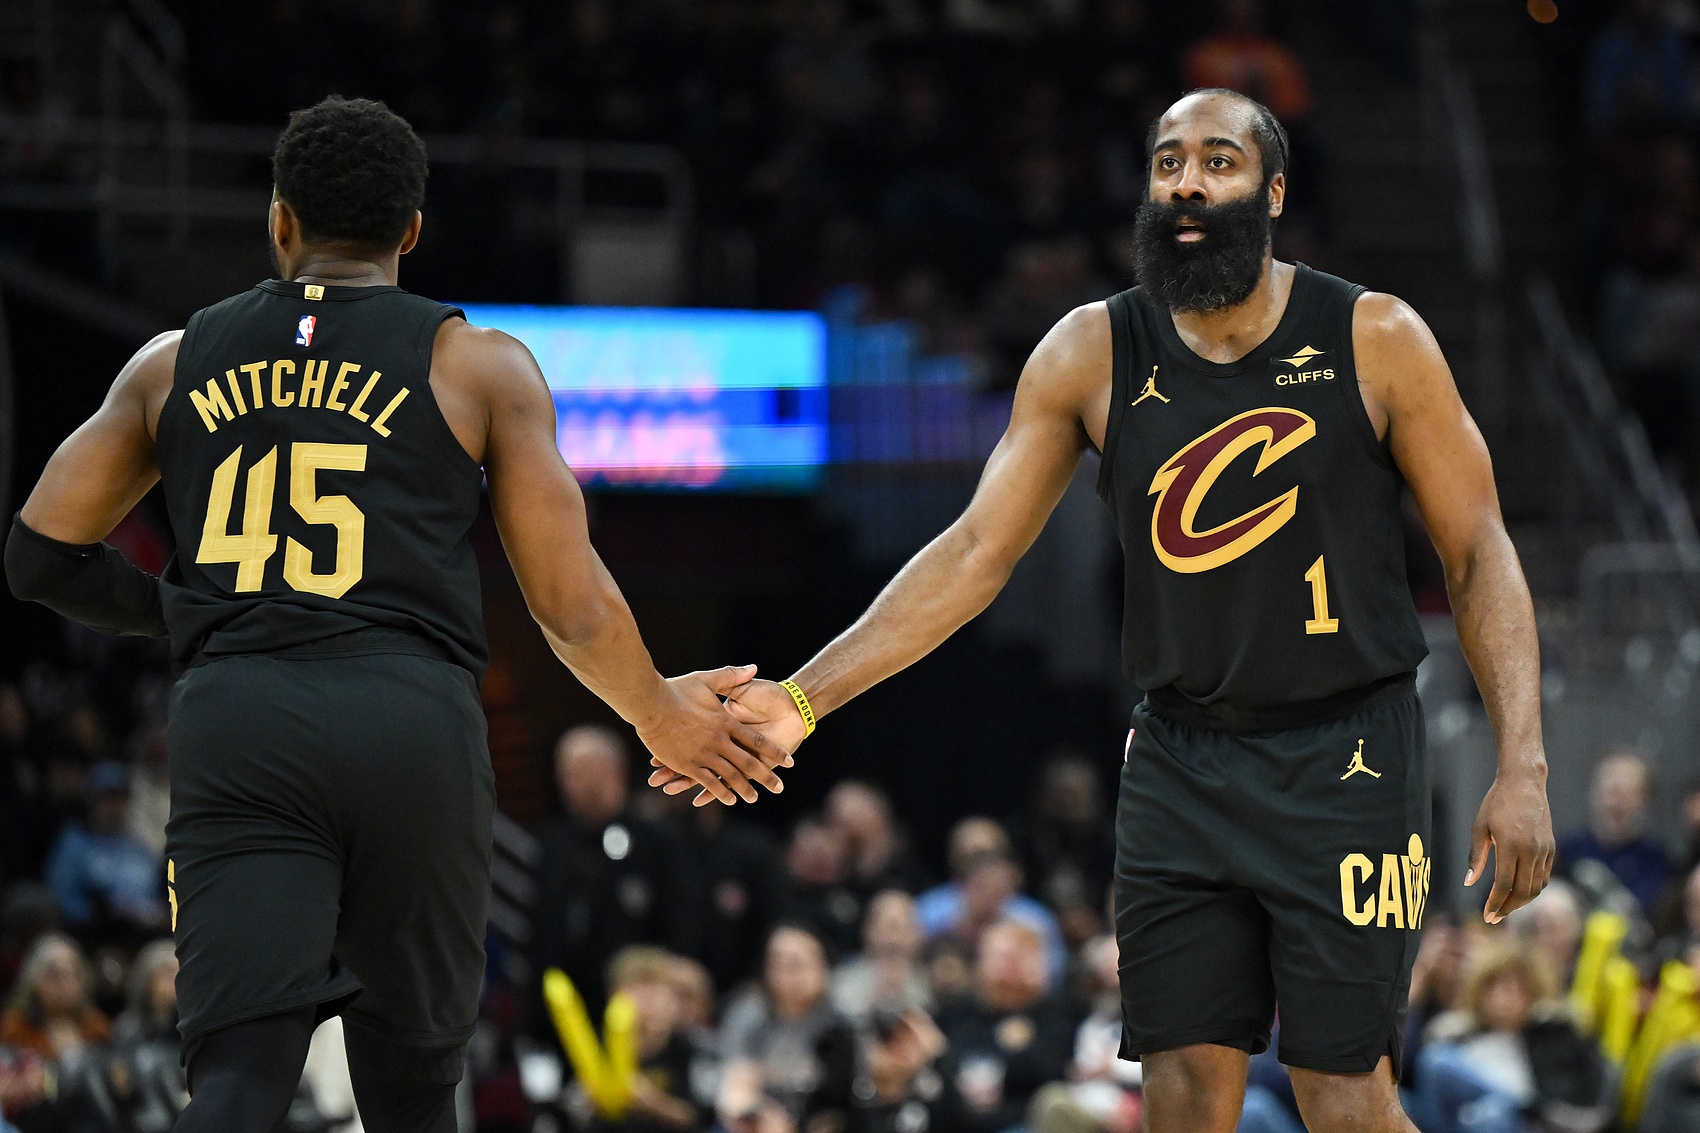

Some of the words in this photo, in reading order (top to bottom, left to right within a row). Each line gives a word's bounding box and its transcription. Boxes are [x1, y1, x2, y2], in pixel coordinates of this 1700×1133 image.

[188, 359, 410, 438] MITCHELL
[1275, 368, 1335, 386] CLIFFS
[195, 442, 368, 600] 45
[1147, 406, 1317, 574] C
[1304, 554, 1339, 635] 1
